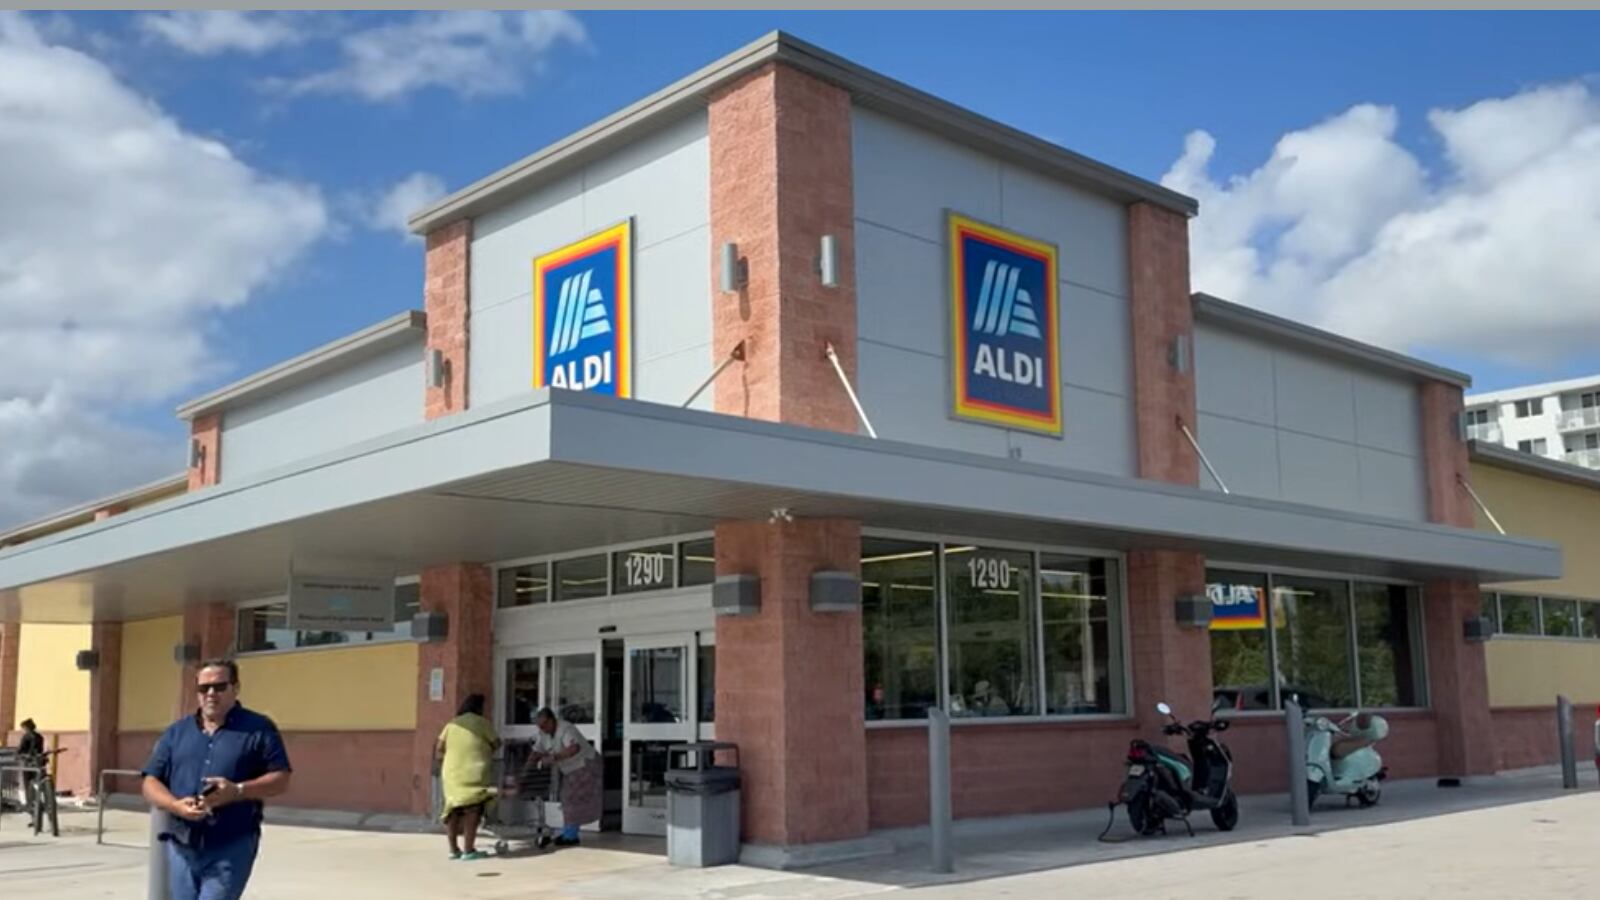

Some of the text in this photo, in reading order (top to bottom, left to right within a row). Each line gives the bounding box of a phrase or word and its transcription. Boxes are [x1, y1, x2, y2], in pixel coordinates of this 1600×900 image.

[551, 350, 611, 391] ALDI
[974, 343, 1043, 388] ALDI
[625, 553, 663, 586] 1290
[968, 557, 1009, 588] 1290
